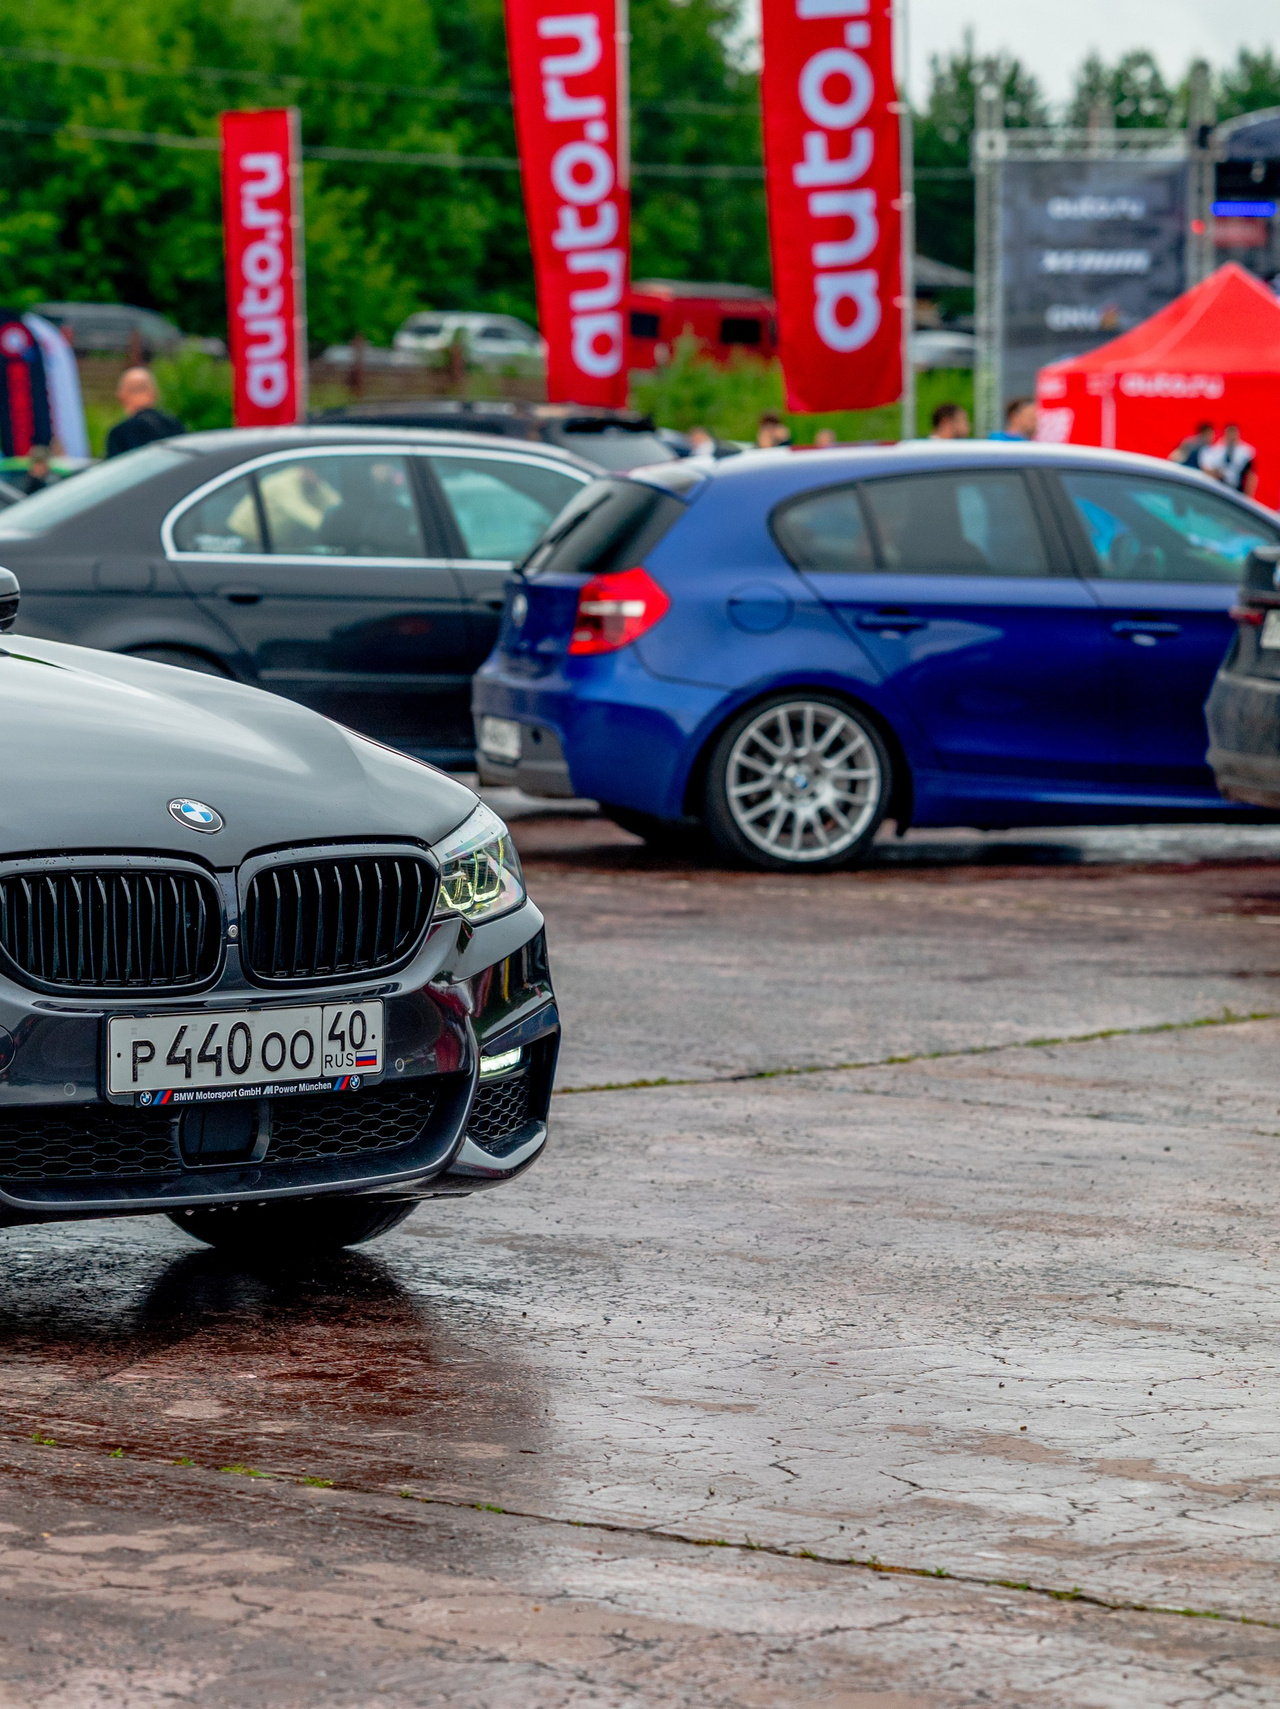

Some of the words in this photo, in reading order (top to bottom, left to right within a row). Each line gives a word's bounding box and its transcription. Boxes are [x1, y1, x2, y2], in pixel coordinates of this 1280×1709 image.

[537, 13, 625, 378] auto.ru
[238, 152, 288, 408] auto.ru
[328, 1009, 367, 1051] 40
[325, 1052, 354, 1068] RUS
[173, 1092, 194, 1101] BMW
[196, 1090, 237, 1100] Motorsport
[238, 1087, 261, 1097] GmbH
[298, 1081, 332, 1092] München
